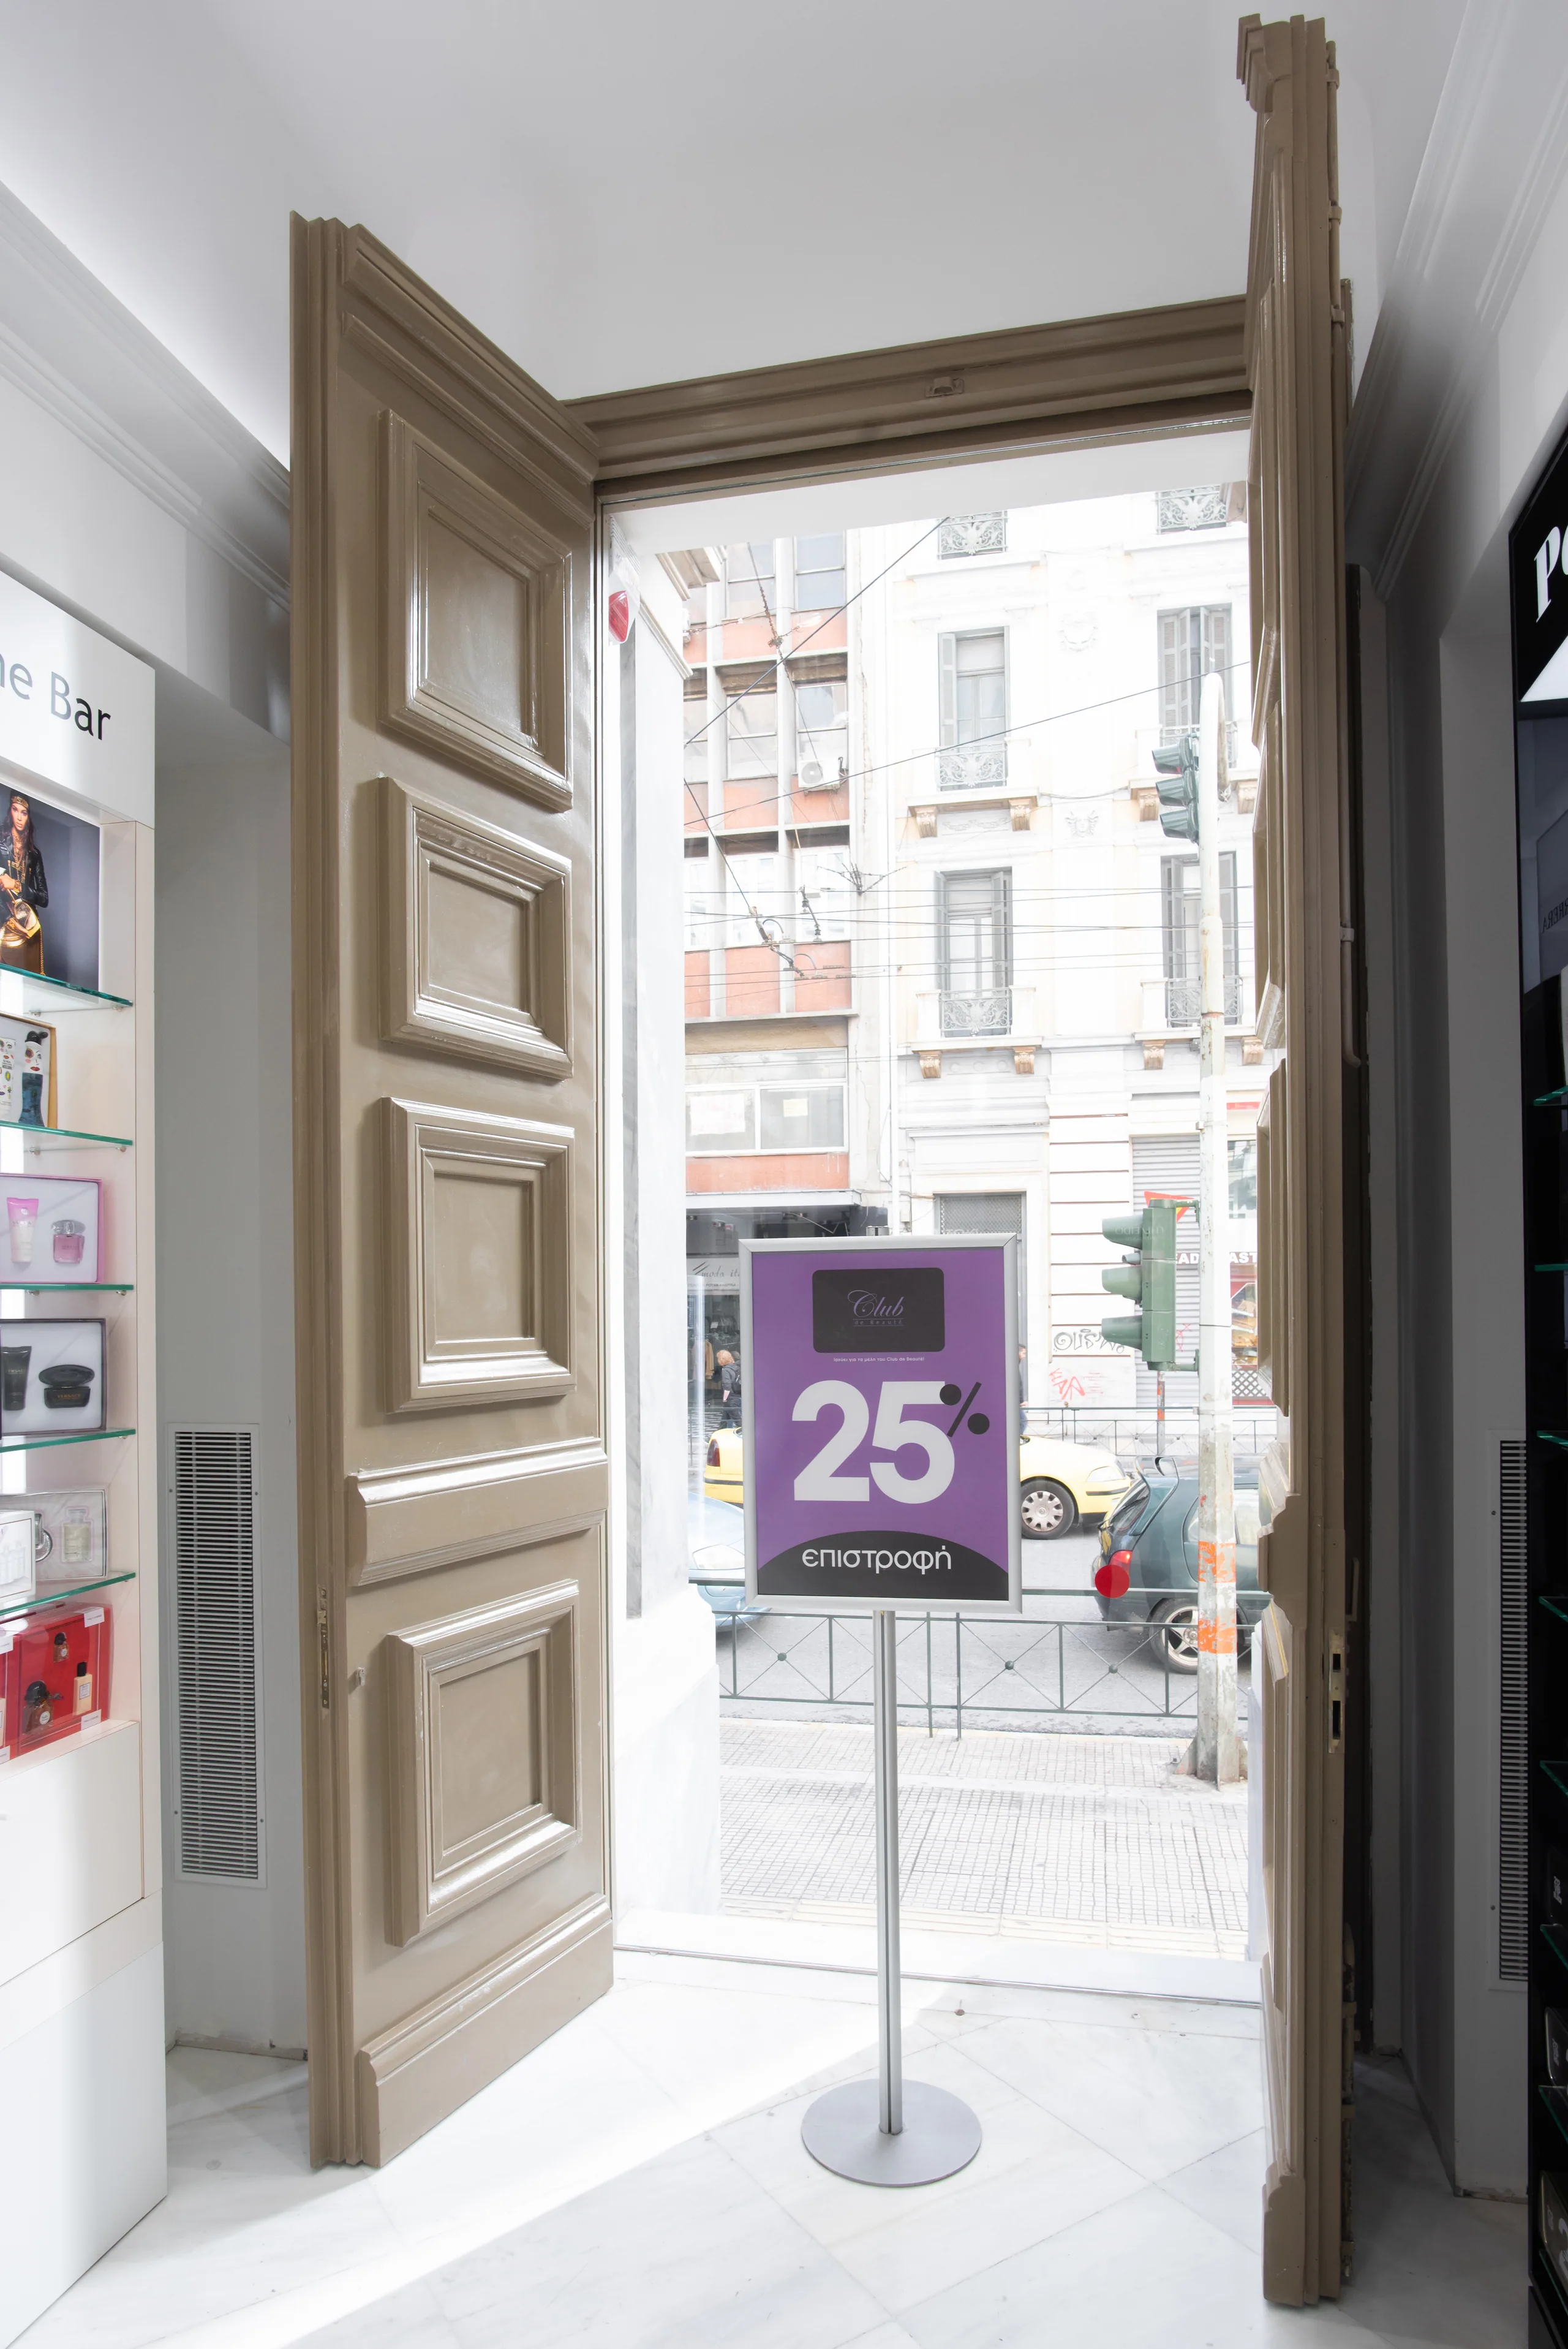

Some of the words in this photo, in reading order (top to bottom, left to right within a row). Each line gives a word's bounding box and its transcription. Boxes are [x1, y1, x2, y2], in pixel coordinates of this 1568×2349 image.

[1533, 523, 1568, 622] P
[51, 671, 111, 741] Bar
[730, 1268, 740, 1277] it
[848, 1290, 905, 1318] Club
[792, 1380, 990, 1504] 25%
[802, 1545, 952, 1575] επιστροφή
